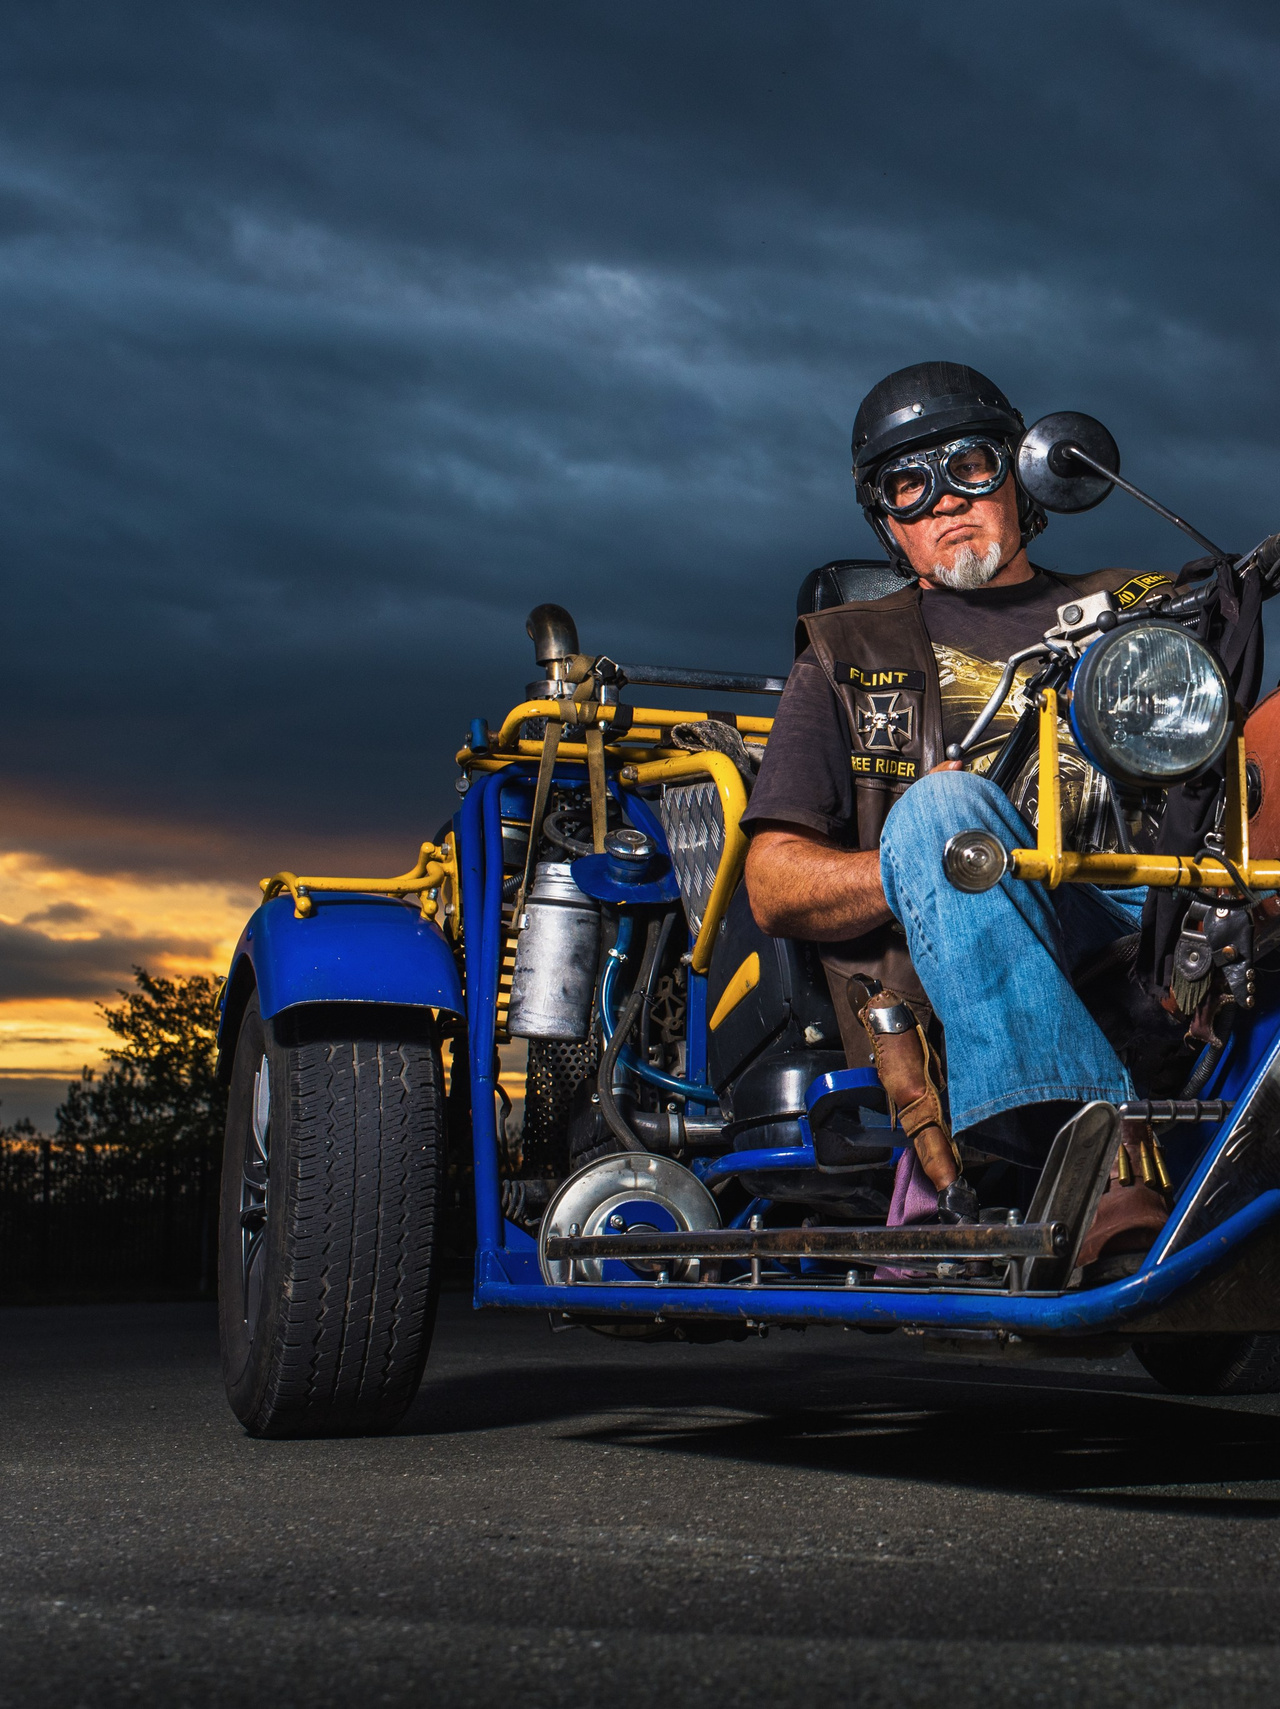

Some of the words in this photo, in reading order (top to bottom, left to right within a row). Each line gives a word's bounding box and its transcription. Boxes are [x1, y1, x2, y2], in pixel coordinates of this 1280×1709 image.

[849, 667, 908, 687] FLINT
[851, 756, 871, 771] REE
[875, 758, 915, 777] RIDER
